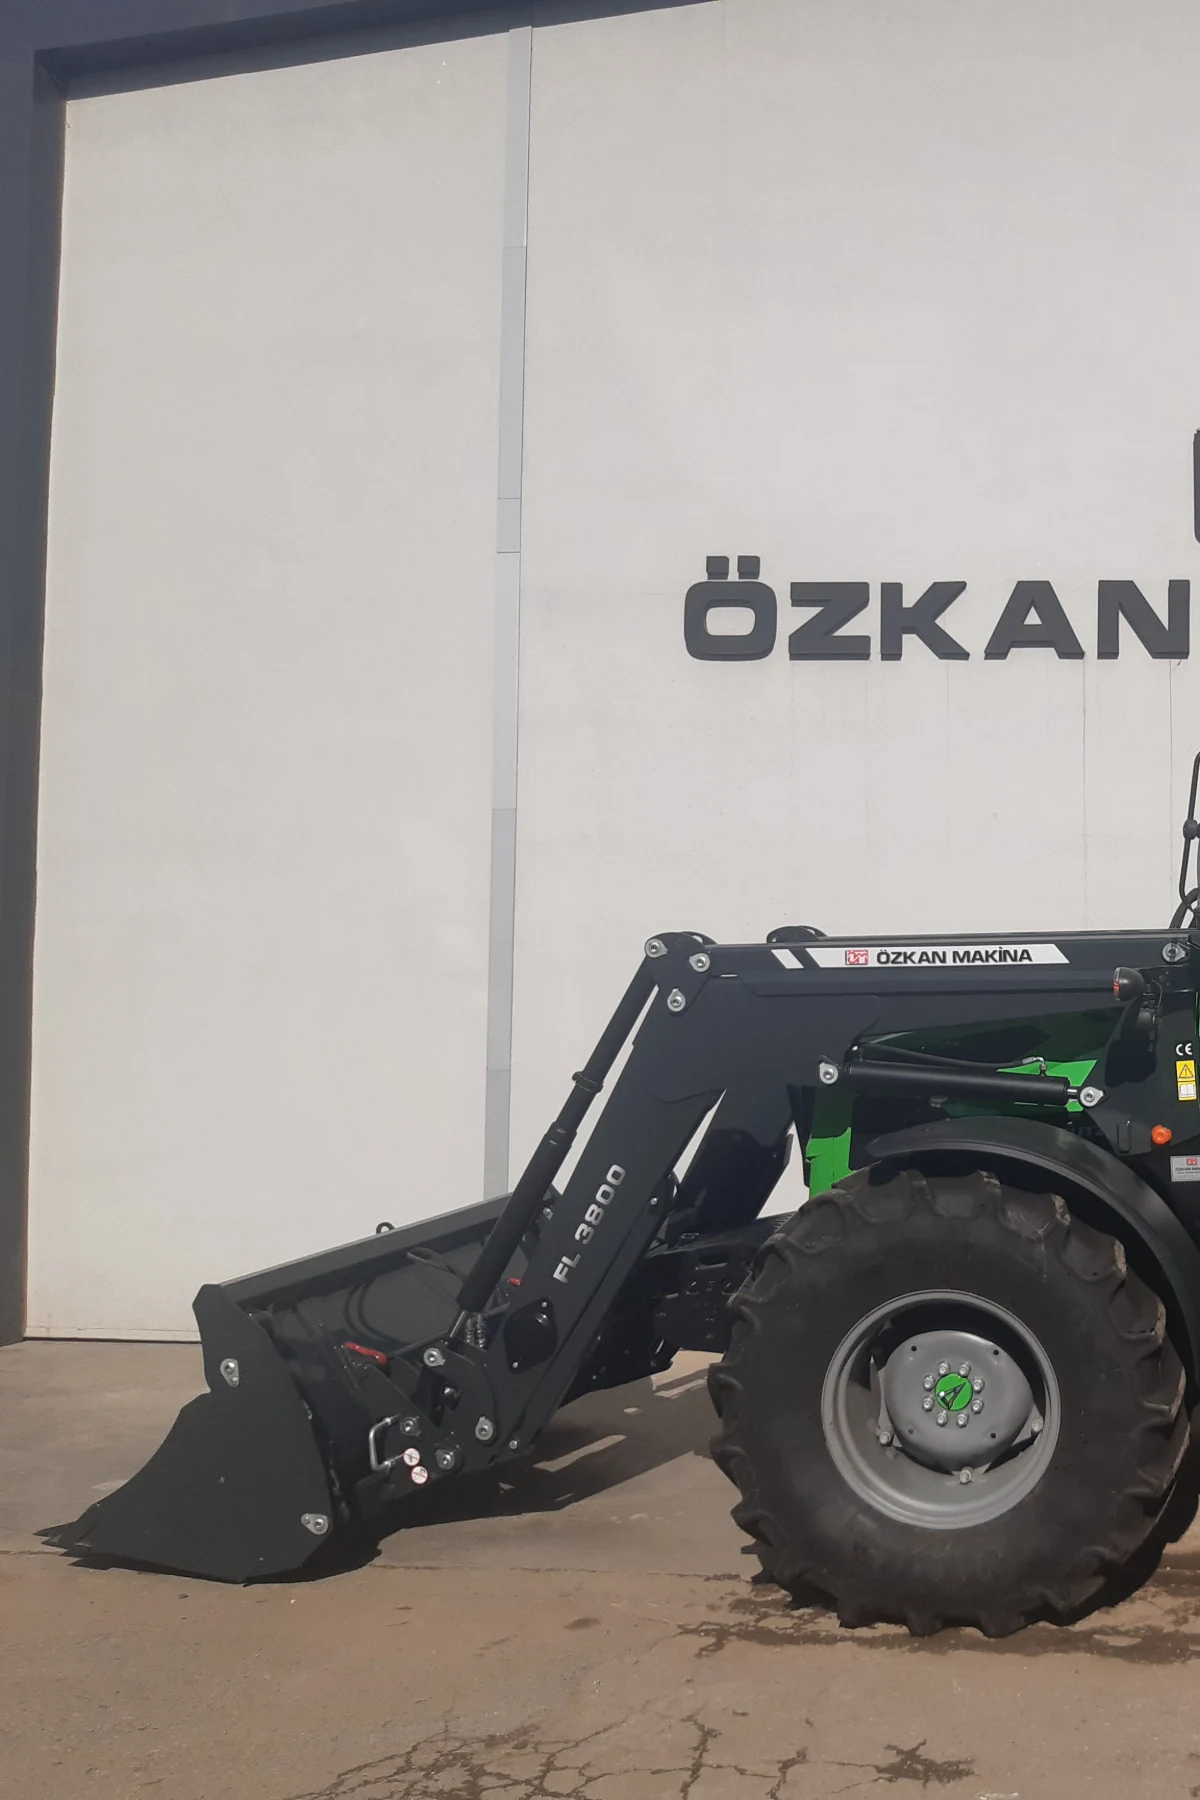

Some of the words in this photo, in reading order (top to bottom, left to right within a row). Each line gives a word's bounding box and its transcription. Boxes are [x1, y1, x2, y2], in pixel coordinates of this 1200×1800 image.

[684, 555, 1190, 661] ÖZKAN
[876, 949, 947, 965] ÖZKAN
[952, 946, 1033, 964] MAKİNA
[1175, 1042, 1193, 1056] CE
[552, 1252, 582, 1284] FL
[574, 1163, 627, 1245] 3800
